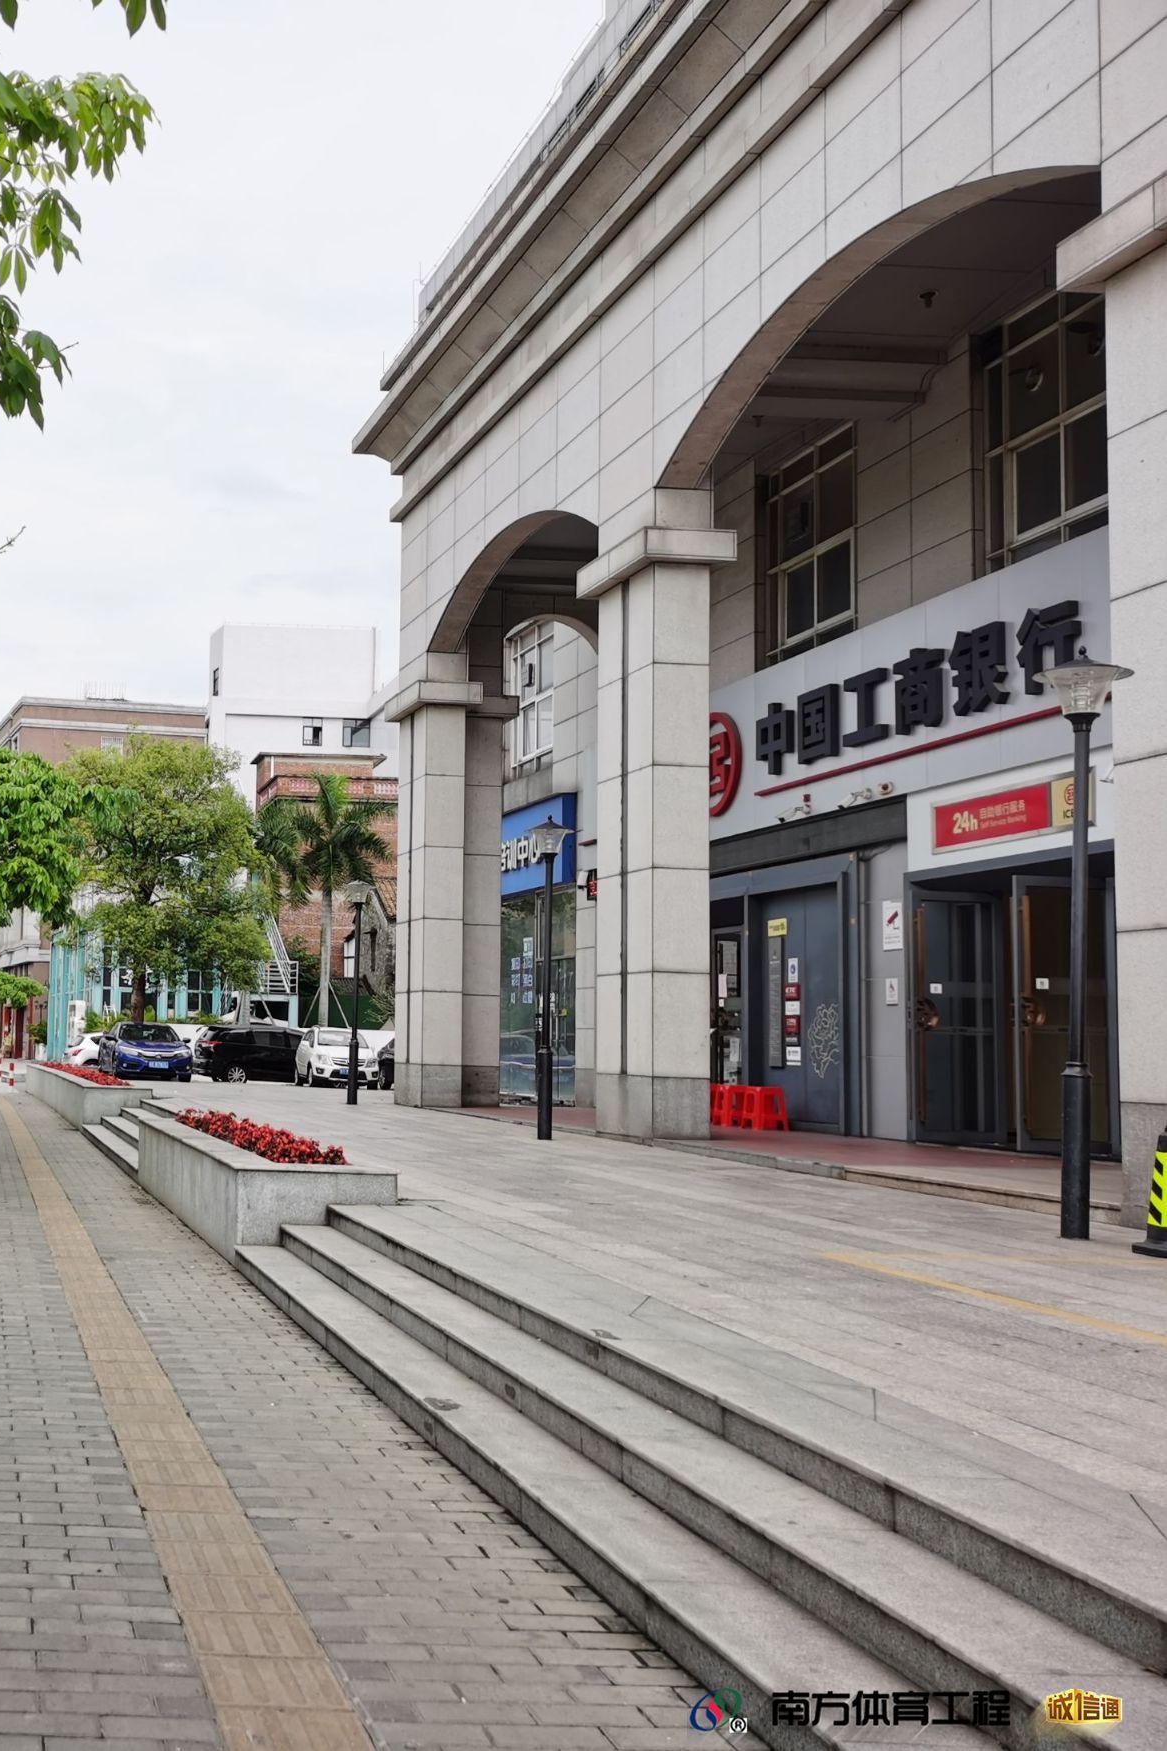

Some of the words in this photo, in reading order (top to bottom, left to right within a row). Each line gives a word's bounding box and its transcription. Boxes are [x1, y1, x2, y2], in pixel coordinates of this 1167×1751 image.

[756, 600, 1081, 775] 中国工商银行
[979, 799, 1026, 820] 自助银行服务
[952, 810, 978, 835] 24h
